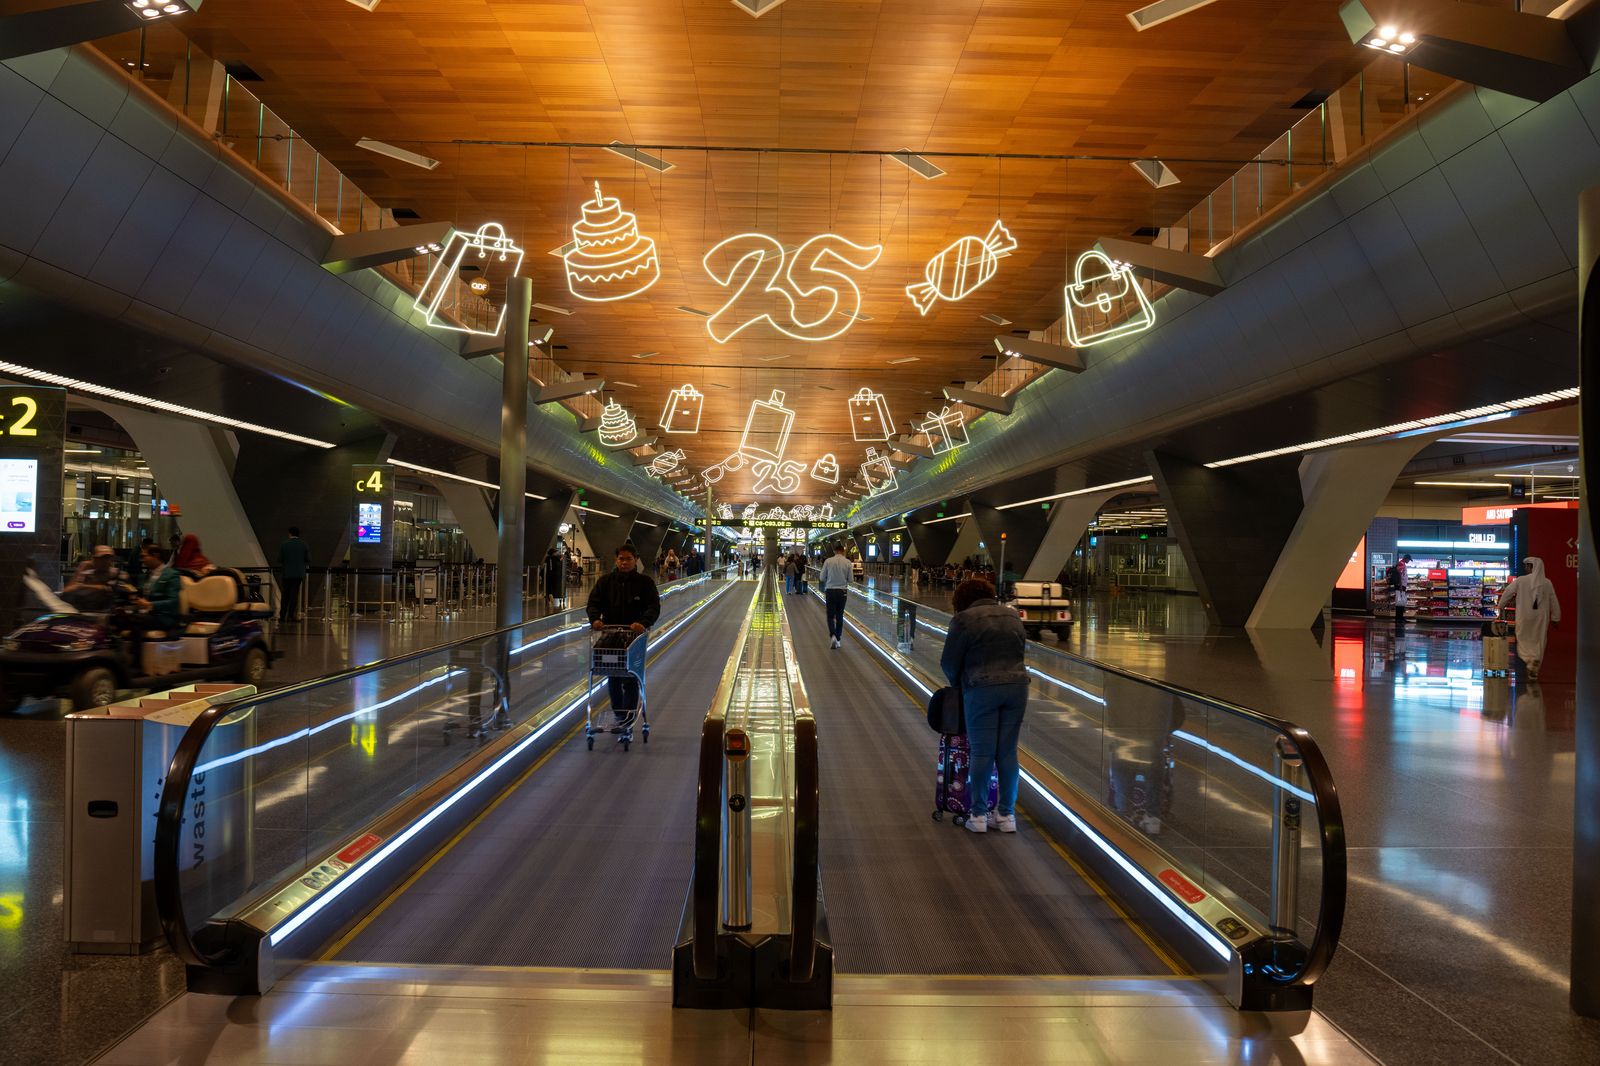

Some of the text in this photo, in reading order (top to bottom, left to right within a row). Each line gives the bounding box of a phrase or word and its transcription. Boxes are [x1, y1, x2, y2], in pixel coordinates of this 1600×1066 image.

[472, 283, 487, 291] QDF
[703, 232, 882, 344] 25
[751, 459, 808, 494] 25
[1469, 533, 1496, 543] CHILLED
[191, 771, 206, 870] waste
